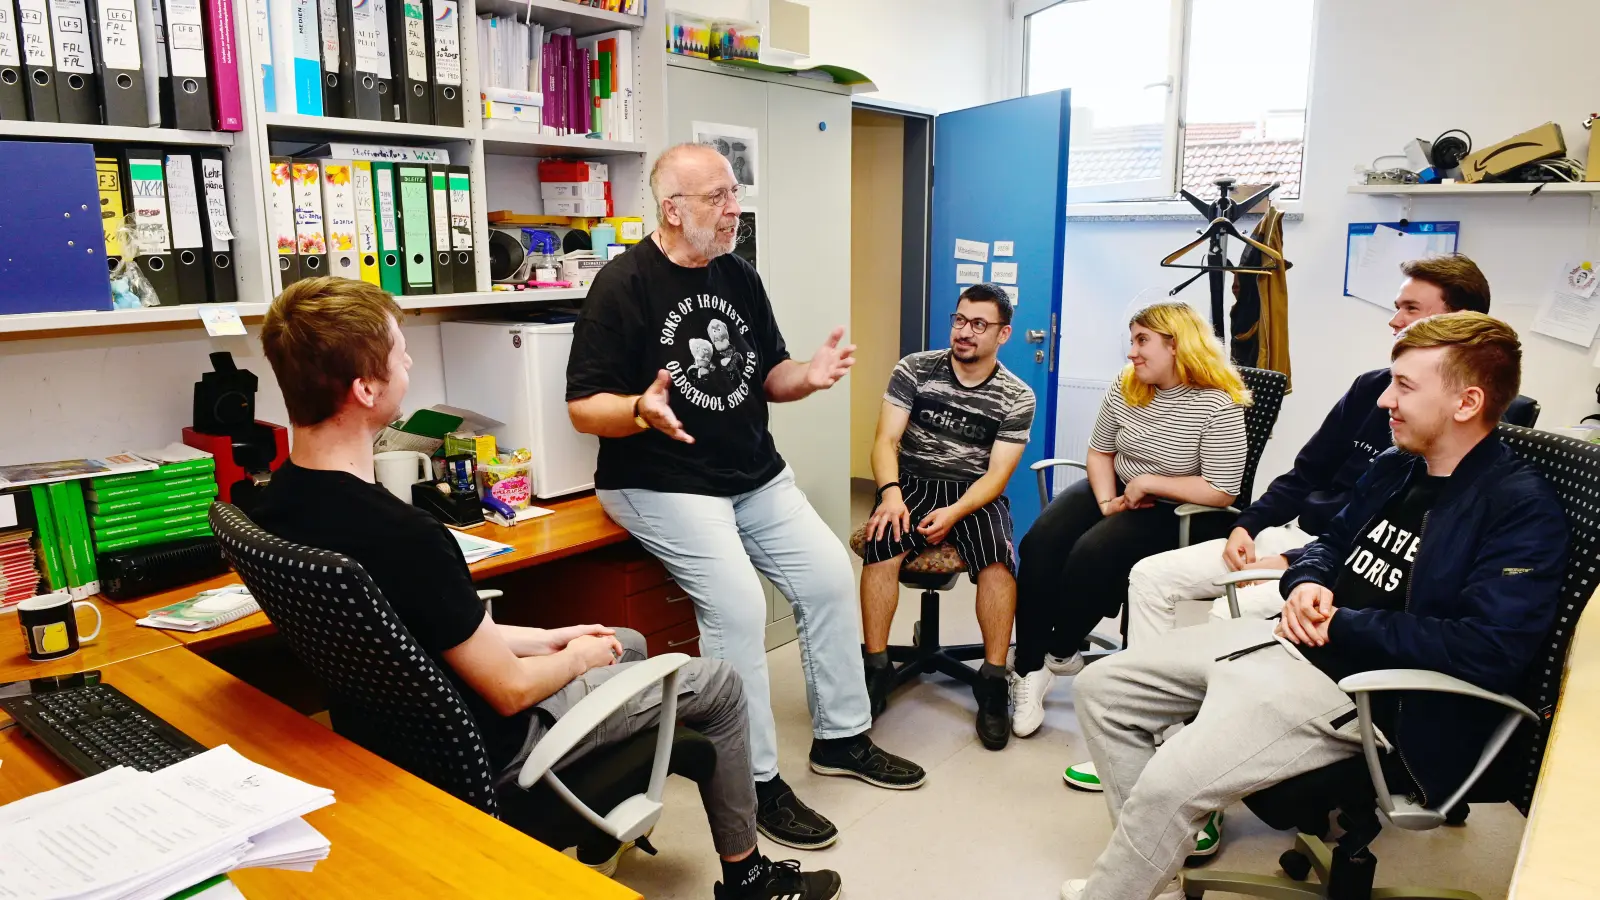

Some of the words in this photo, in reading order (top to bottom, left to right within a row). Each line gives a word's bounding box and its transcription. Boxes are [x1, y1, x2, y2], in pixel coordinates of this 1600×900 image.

[106, 22, 127, 31] FAL
[408, 20, 418, 28] AP
[26, 34, 44, 44] FAL
[408, 30, 420, 39] FAL
[106, 36, 126, 46] FPL
[62, 42, 84, 54] FAL
[28, 50, 46, 58] FPL
[63, 57, 85, 68] FPL
[108, 174, 116, 188] 3
[358, 196, 370, 206] VK
[660, 310, 682, 346] SONS
[678, 298, 694, 314] OF
[697, 294, 749, 334] IRONISTS
[666, 360, 724, 411] OLDSCHOOL
[728, 379, 748, 408] SINCE
[742, 352, 756, 379] 1976
[920, 410, 986, 440] adidas
[748, 864, 758, 876] GO
